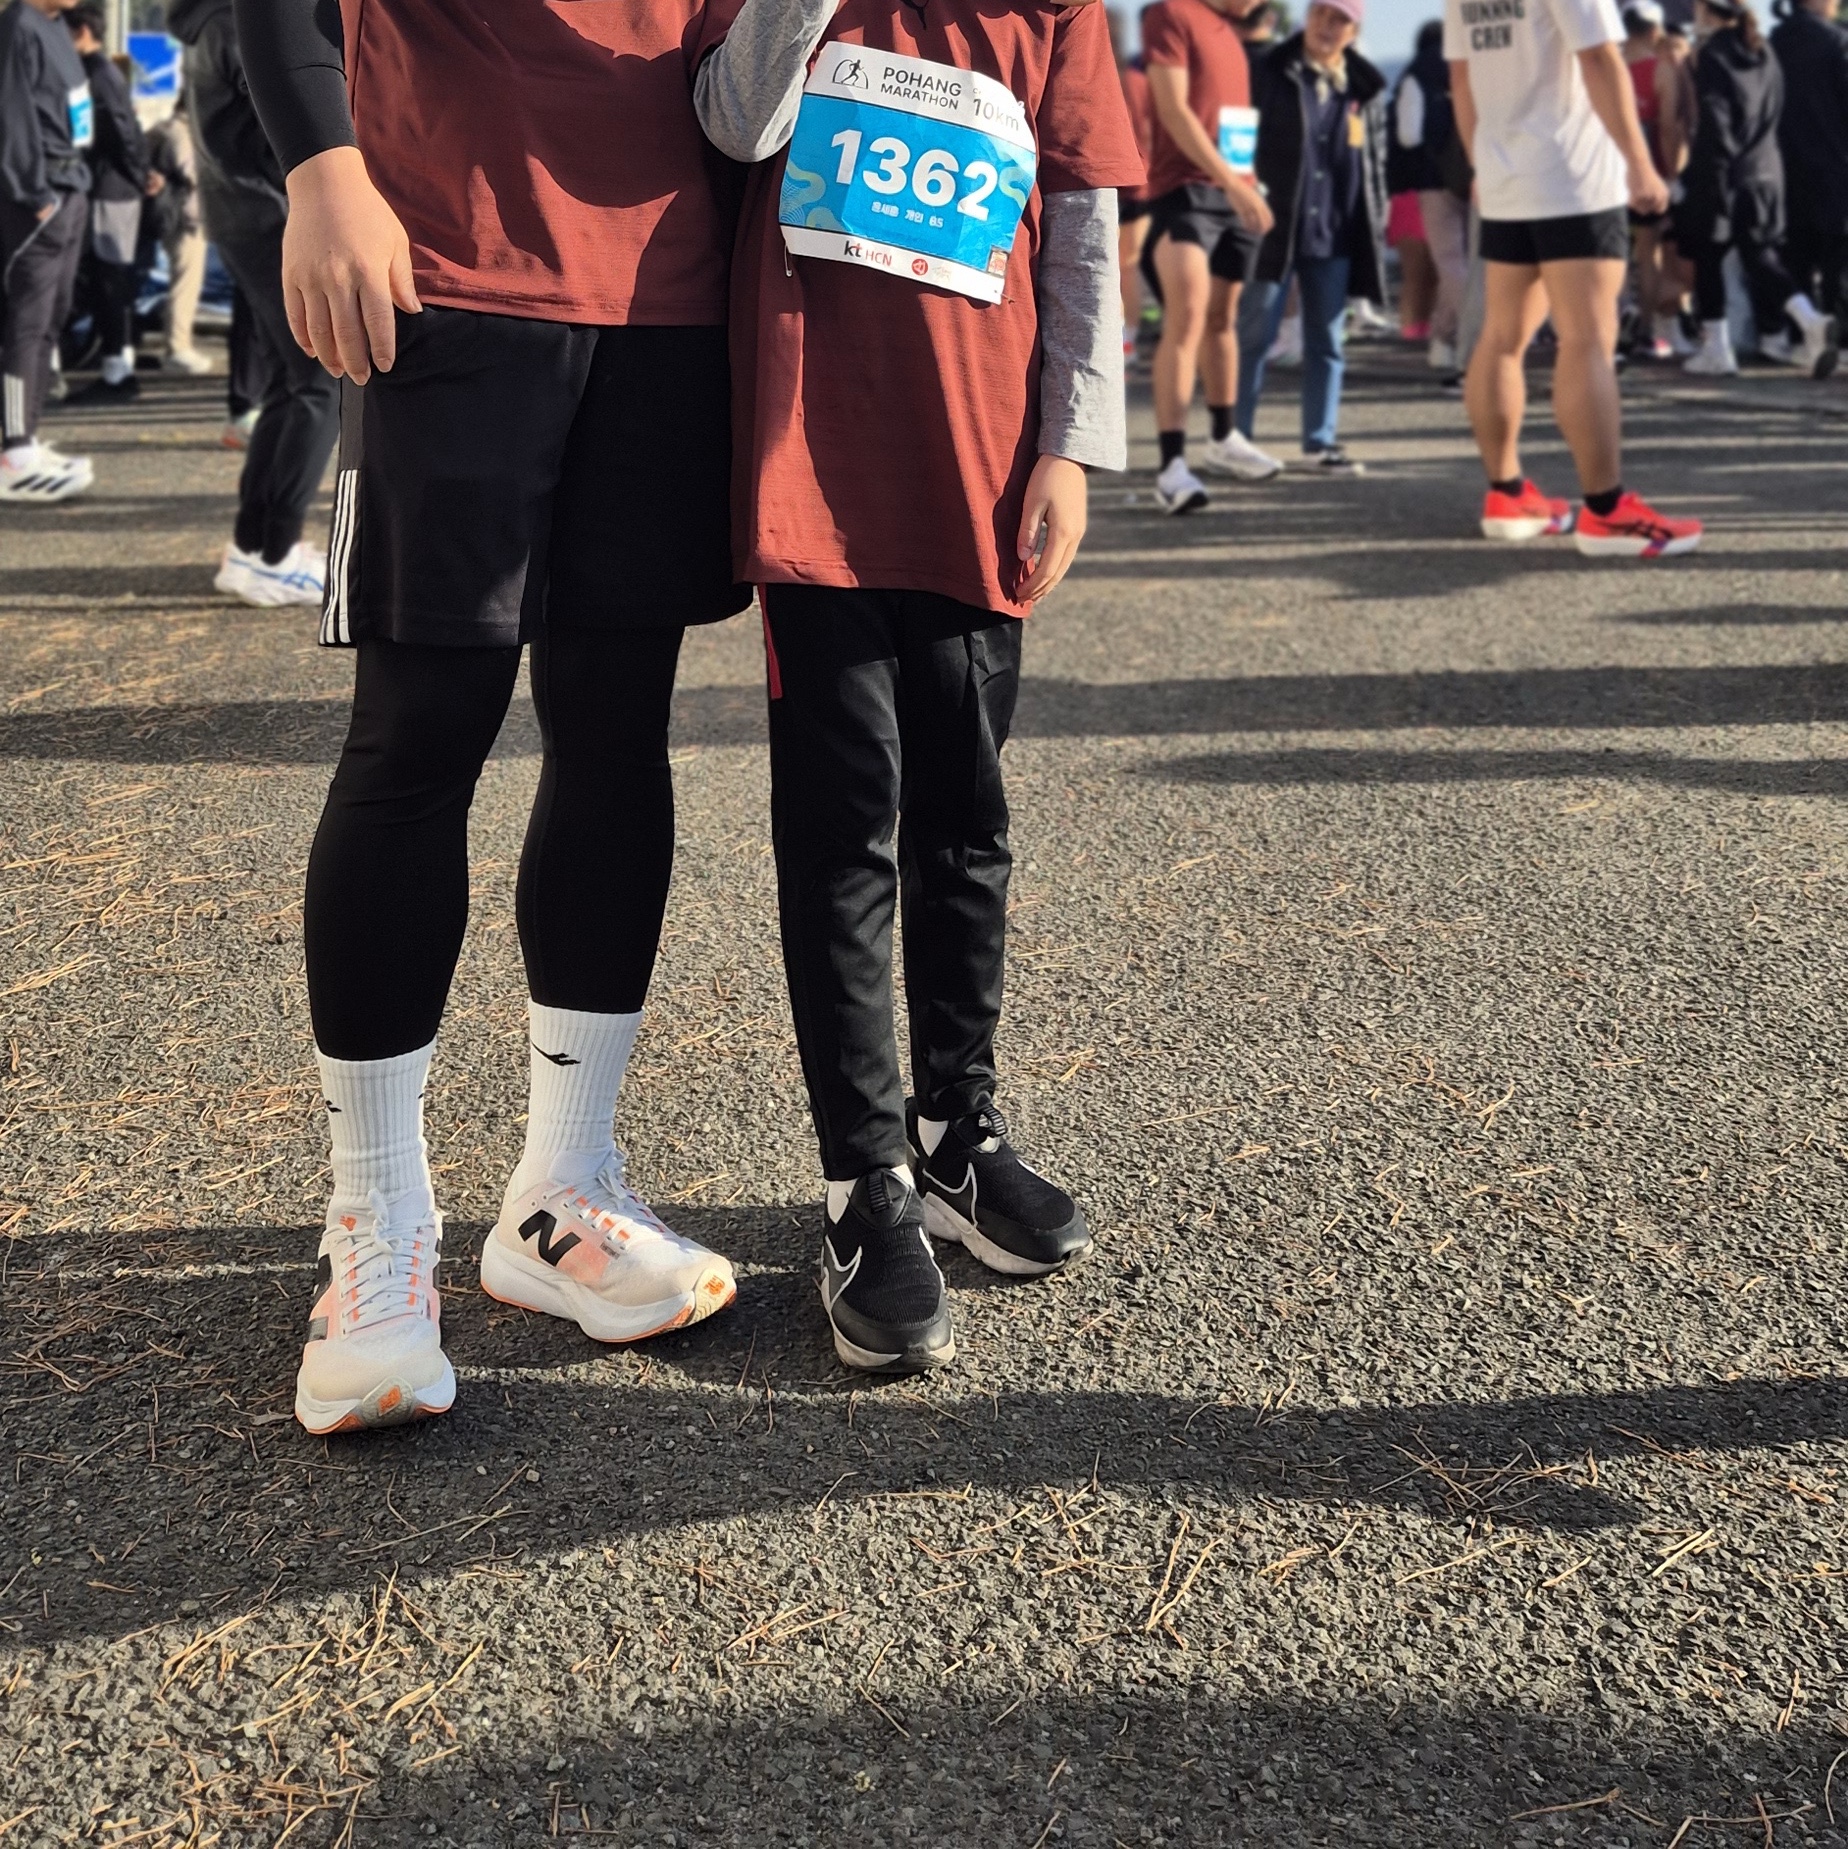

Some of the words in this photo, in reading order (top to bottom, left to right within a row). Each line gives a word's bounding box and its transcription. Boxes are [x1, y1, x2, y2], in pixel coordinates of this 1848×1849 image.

[880, 83, 960, 110] MARATHON
[883, 66, 962, 97] POHANG
[972, 98, 1020, 131] 10km
[831, 129, 998, 222] 1362
[843, 240, 863, 259] kt
[865, 250, 893, 267] HCN
[518, 1209, 582, 1267] N
